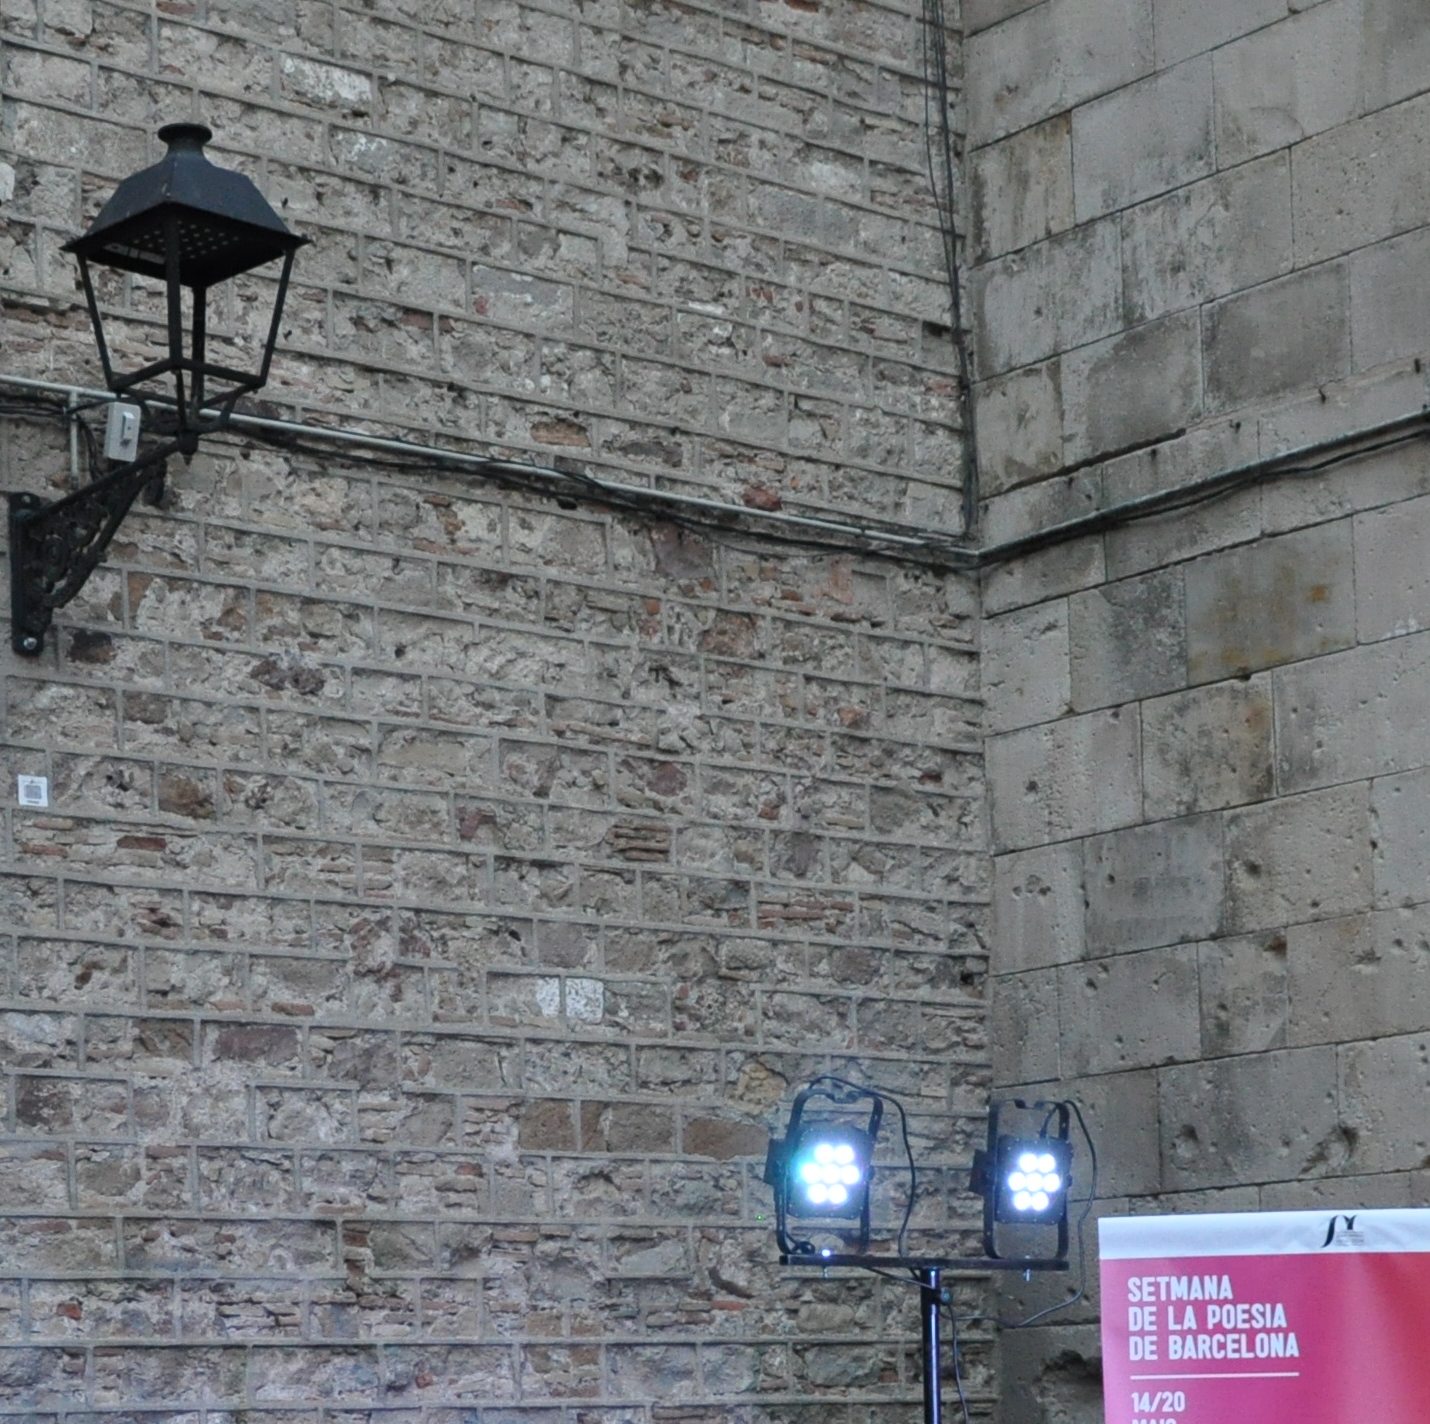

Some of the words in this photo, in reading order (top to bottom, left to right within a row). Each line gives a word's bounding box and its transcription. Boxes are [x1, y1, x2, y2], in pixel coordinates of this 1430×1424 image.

[1127, 1275, 1234, 1302] SETMANA
[1128, 1306, 1158, 1332] DE
[1168, 1305, 1197, 1331] LA
[1207, 1303, 1288, 1330] POESIA
[1129, 1335, 1159, 1361] DE
[1168, 1332, 1300, 1361] BARCELONA
[1131, 1391, 1186, 1413] 14/20
